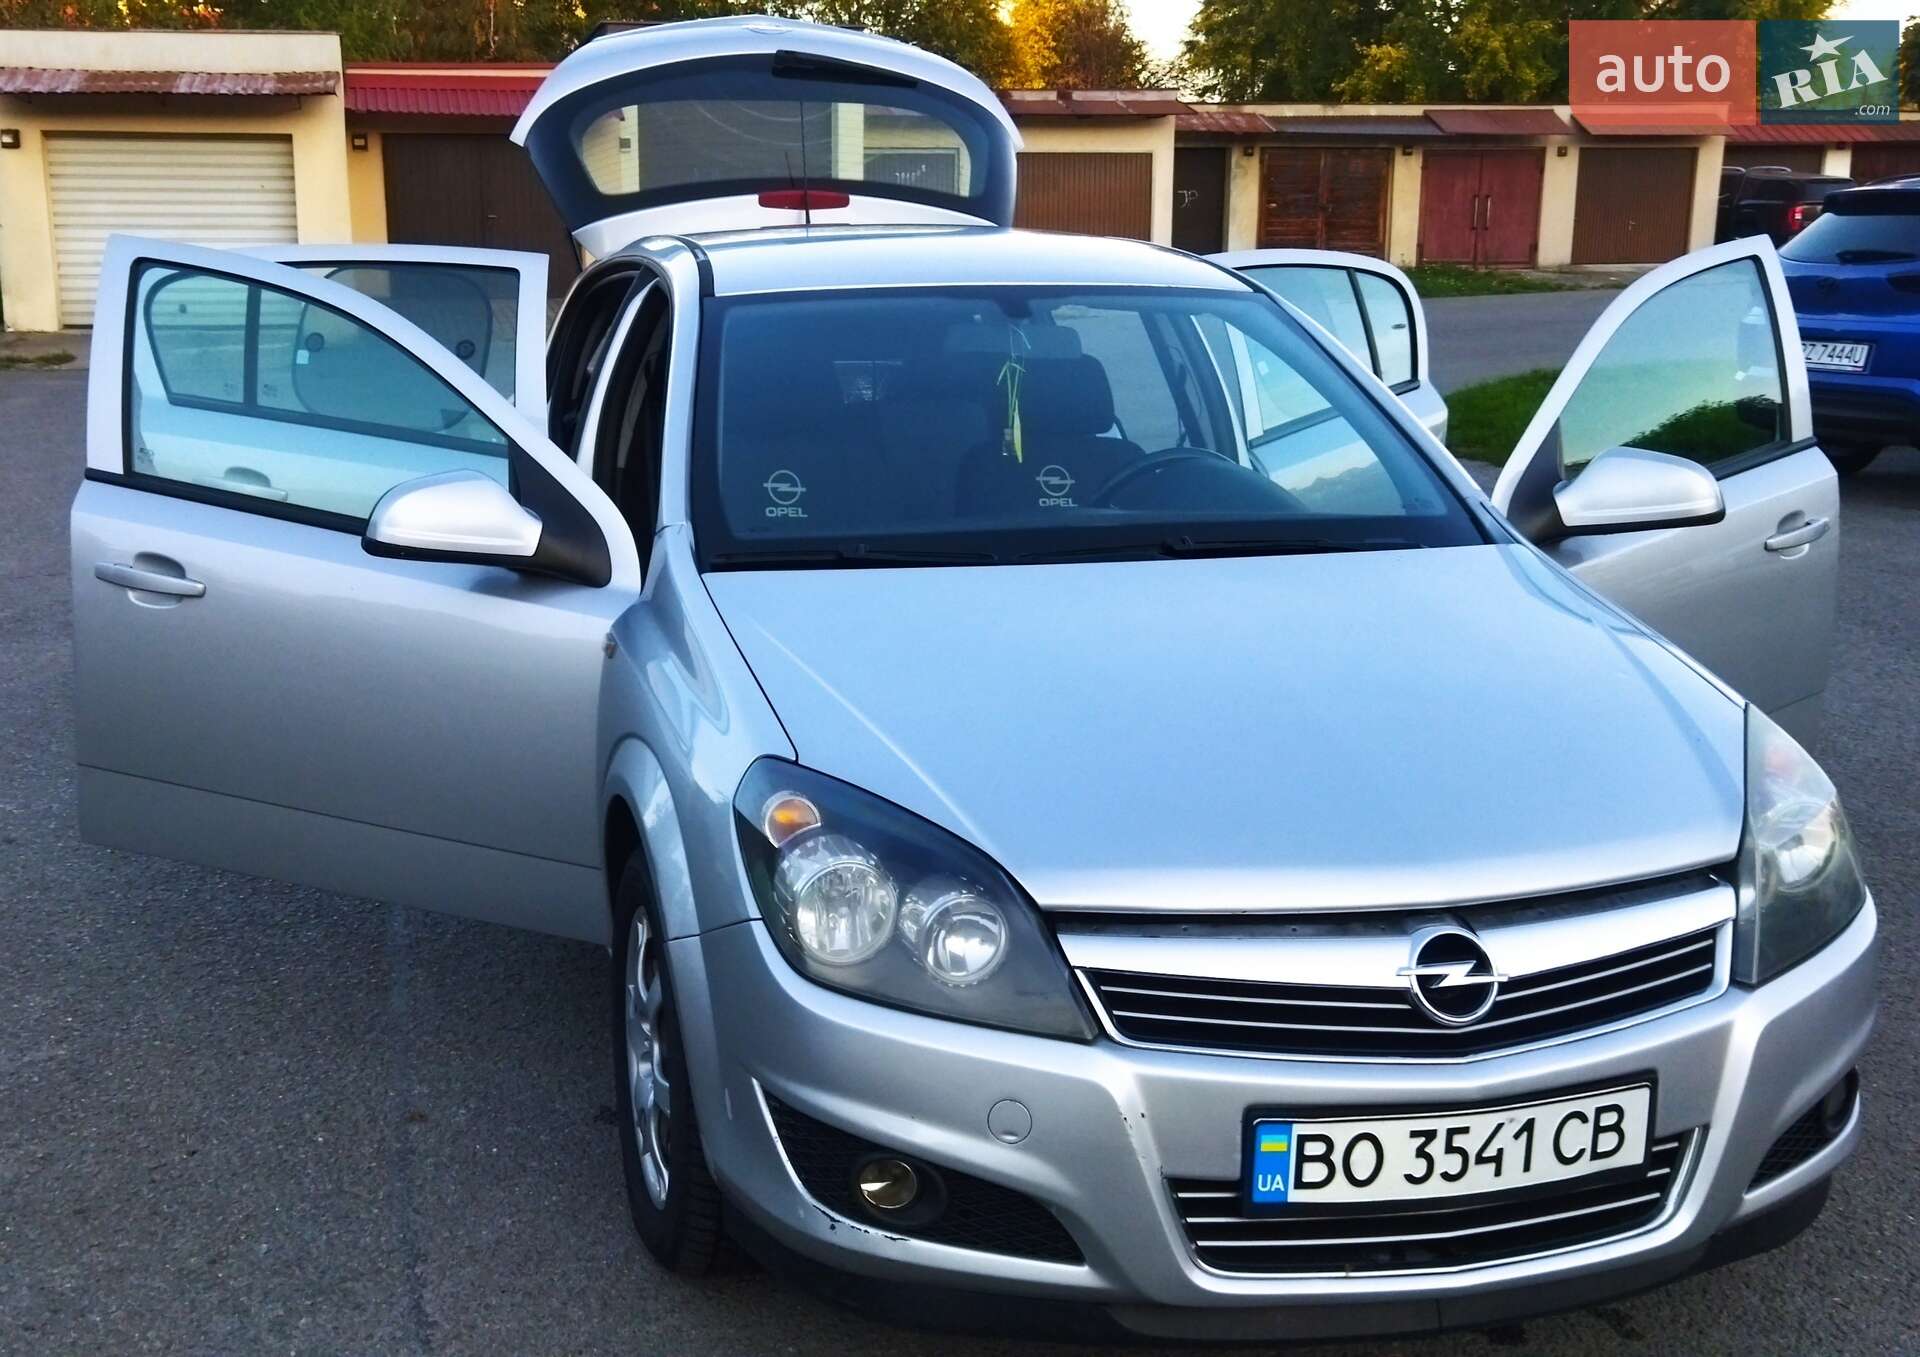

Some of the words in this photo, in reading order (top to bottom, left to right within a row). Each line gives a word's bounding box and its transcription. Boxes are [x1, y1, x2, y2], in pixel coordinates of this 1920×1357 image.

[1038, 498, 1077, 507] OPEL
[765, 507, 807, 517] OPEL
[1293, 1132, 1384, 1190] BO
[1404, 1117, 1536, 1185] 3541
[1552, 1103, 1625, 1165] CB
[1258, 1174, 1285, 1192] UA
